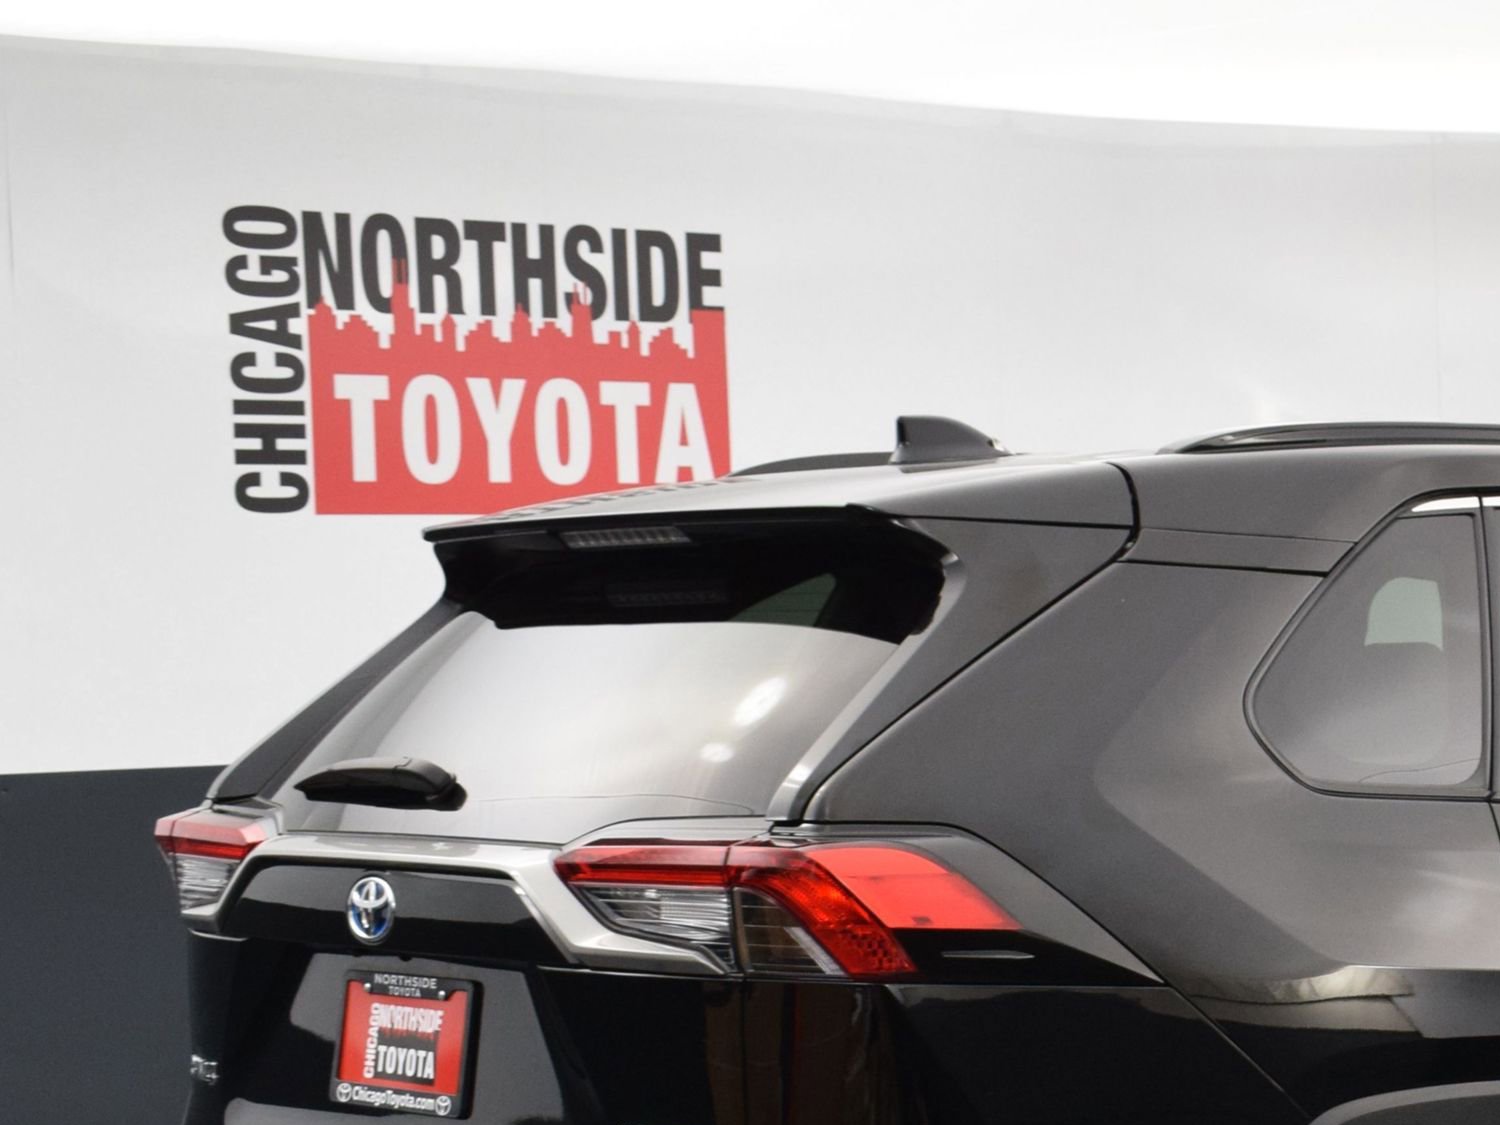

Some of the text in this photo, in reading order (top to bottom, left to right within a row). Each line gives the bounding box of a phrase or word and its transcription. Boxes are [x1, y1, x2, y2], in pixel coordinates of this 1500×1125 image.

[301, 209, 725, 324] NORTHSIDE
[222, 205, 309, 514] CHICAGO
[333, 374, 715, 486] TOYOTA
[374, 974, 438, 990] NORTHSIDE
[388, 986, 421, 997] TOYOTA
[379, 1003, 444, 1033] NORTHSIDE
[363, 1003, 380, 1079] CHICAGO
[377, 1045, 435, 1079] TOYOTA
[352, 1086, 436, 1110] ChicagoToyota.com
